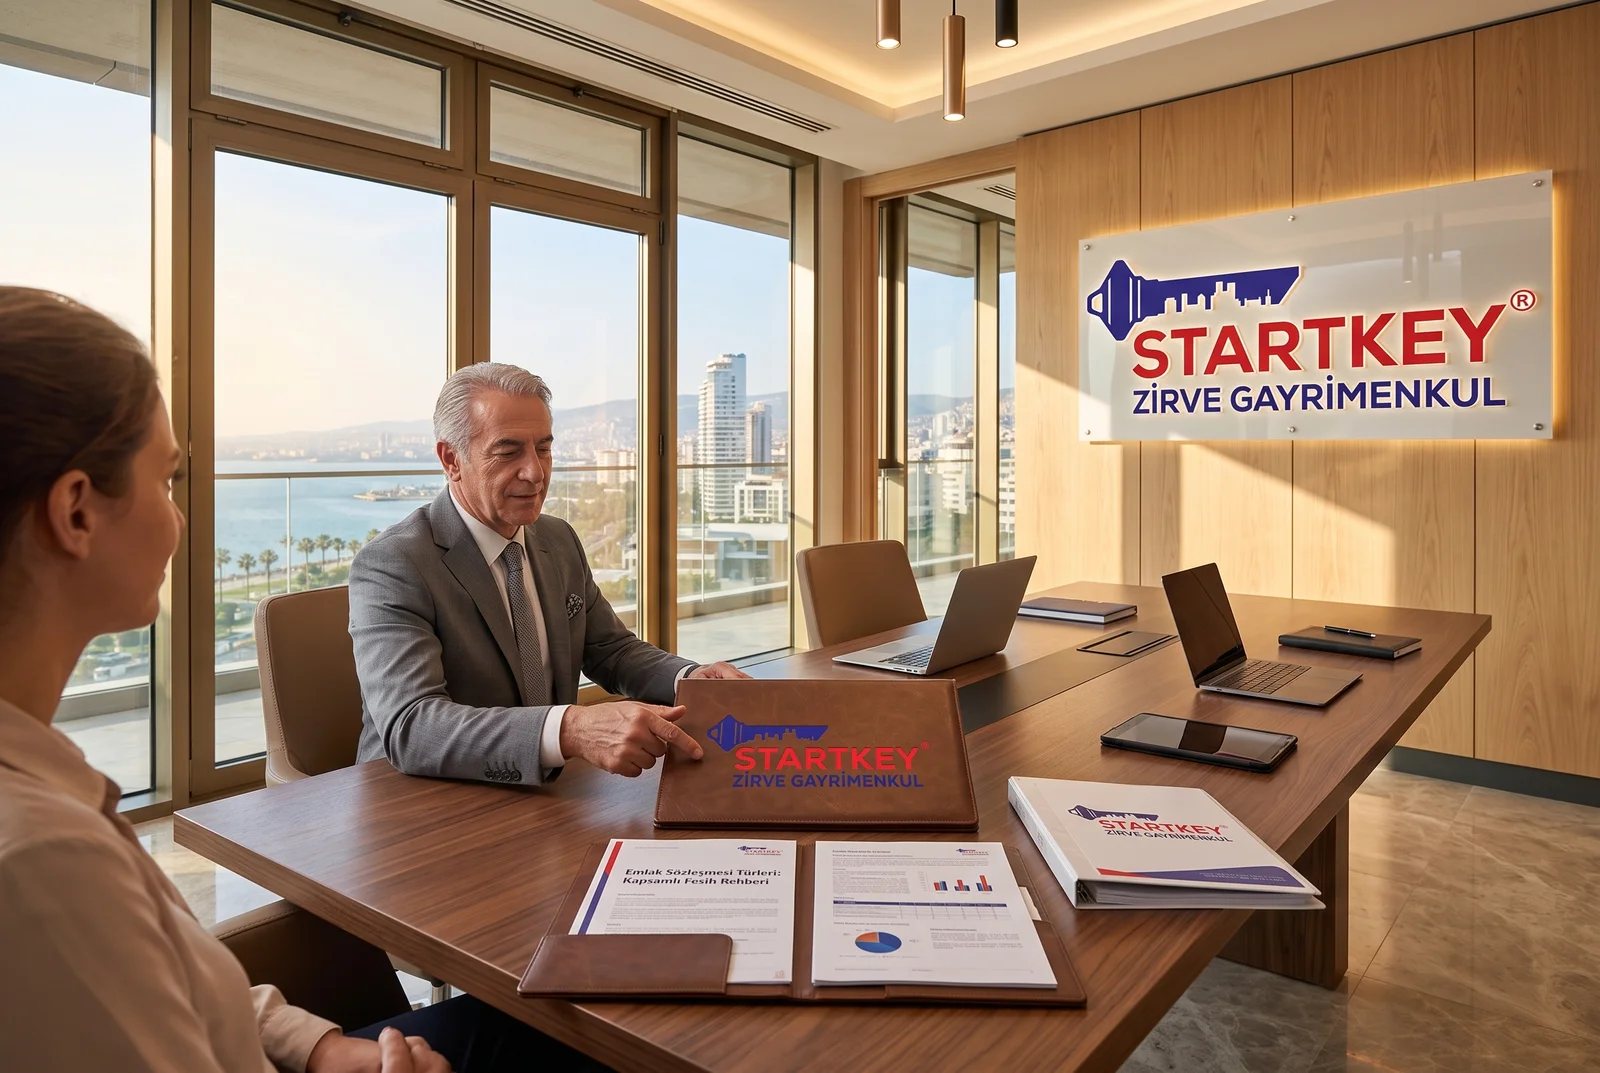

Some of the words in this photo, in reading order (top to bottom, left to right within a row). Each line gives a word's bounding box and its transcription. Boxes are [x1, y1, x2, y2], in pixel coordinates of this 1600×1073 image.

[1132, 382, 1221, 415] ZİRVE
[1230, 374, 1506, 413] GAYRİMENKUL
[732, 771, 786, 788] ZİRVE
[791, 771, 924, 788] GAYRİMENKUL
[625, 868, 662, 876] Emlak
[665, 868, 733, 877] Sözleşmesi
[736, 869, 781, 877] Türleri:
[622, 877, 681, 886] Kapsamlı
[684, 877, 717, 885] Fesih
